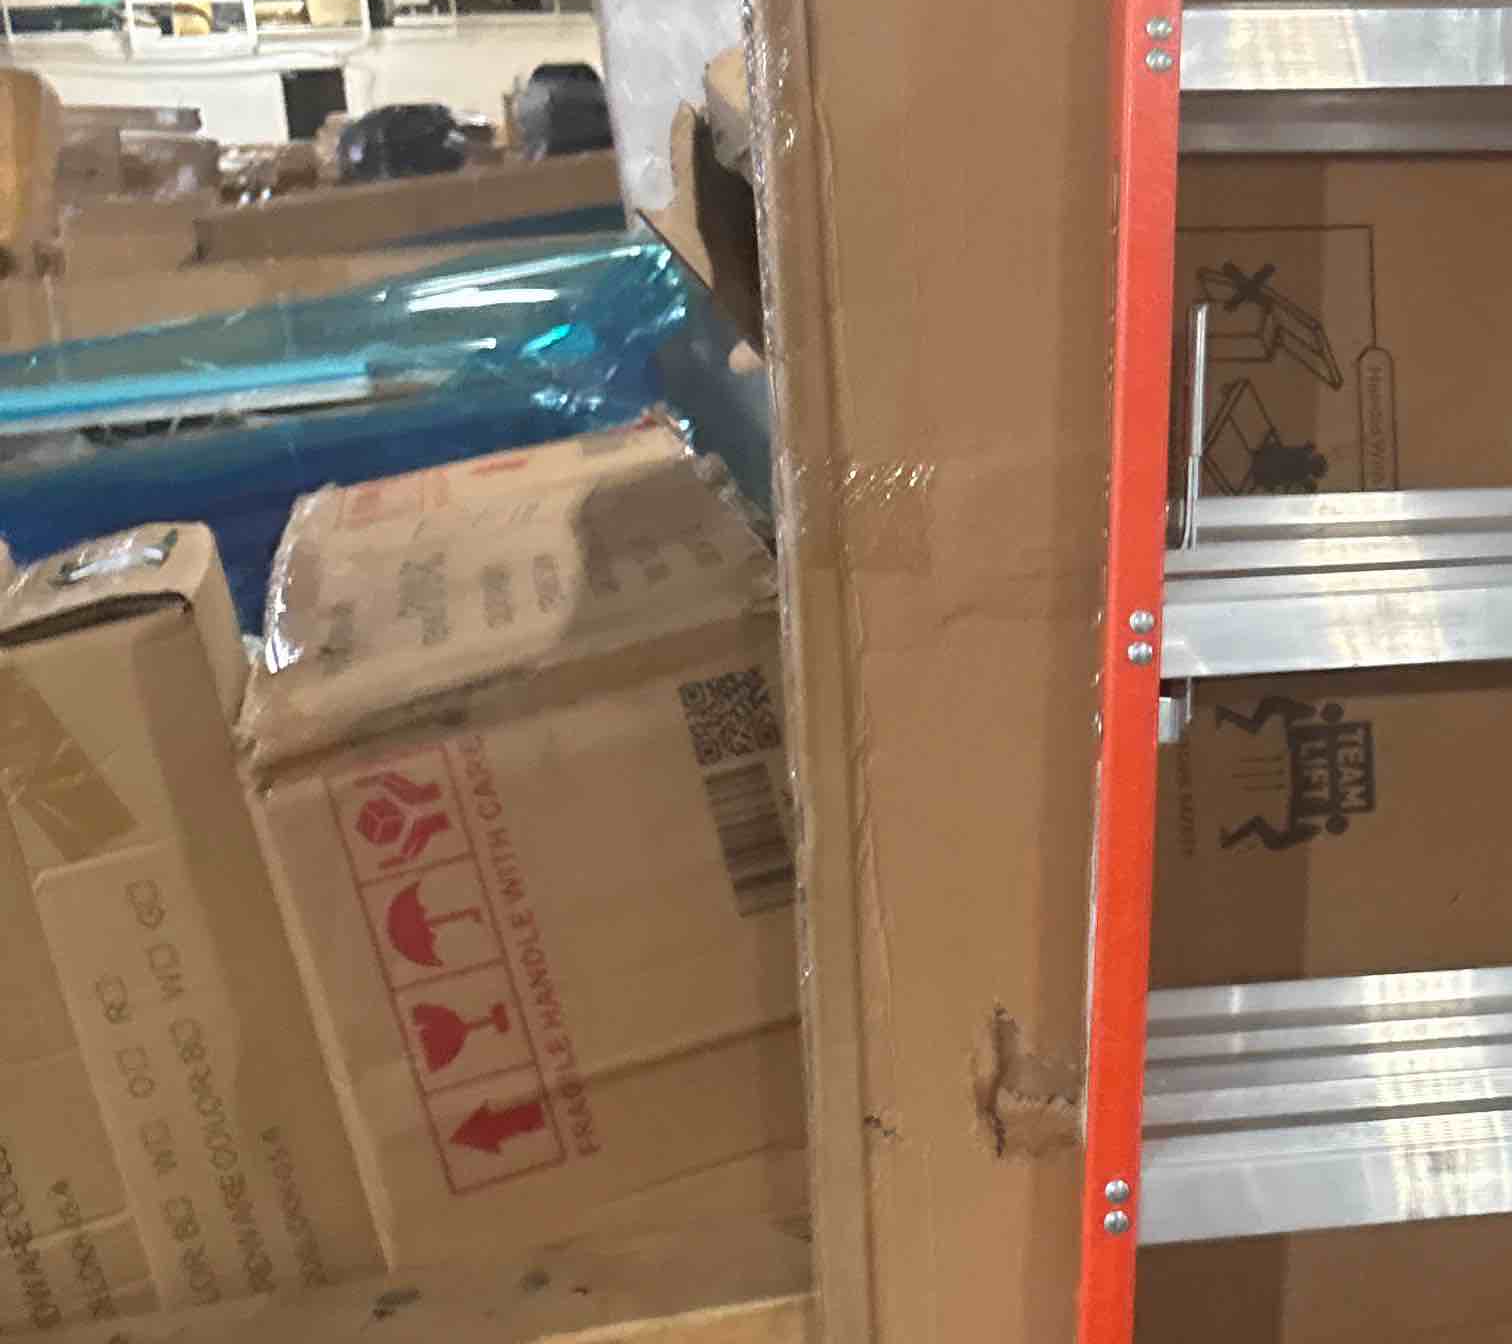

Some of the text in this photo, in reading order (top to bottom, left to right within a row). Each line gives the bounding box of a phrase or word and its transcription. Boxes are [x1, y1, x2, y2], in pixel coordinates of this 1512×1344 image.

[1338, 727, 1367, 809] TEAM
[489, 829, 525, 899] WITH
[511, 907, 564, 1030] HANDLE
